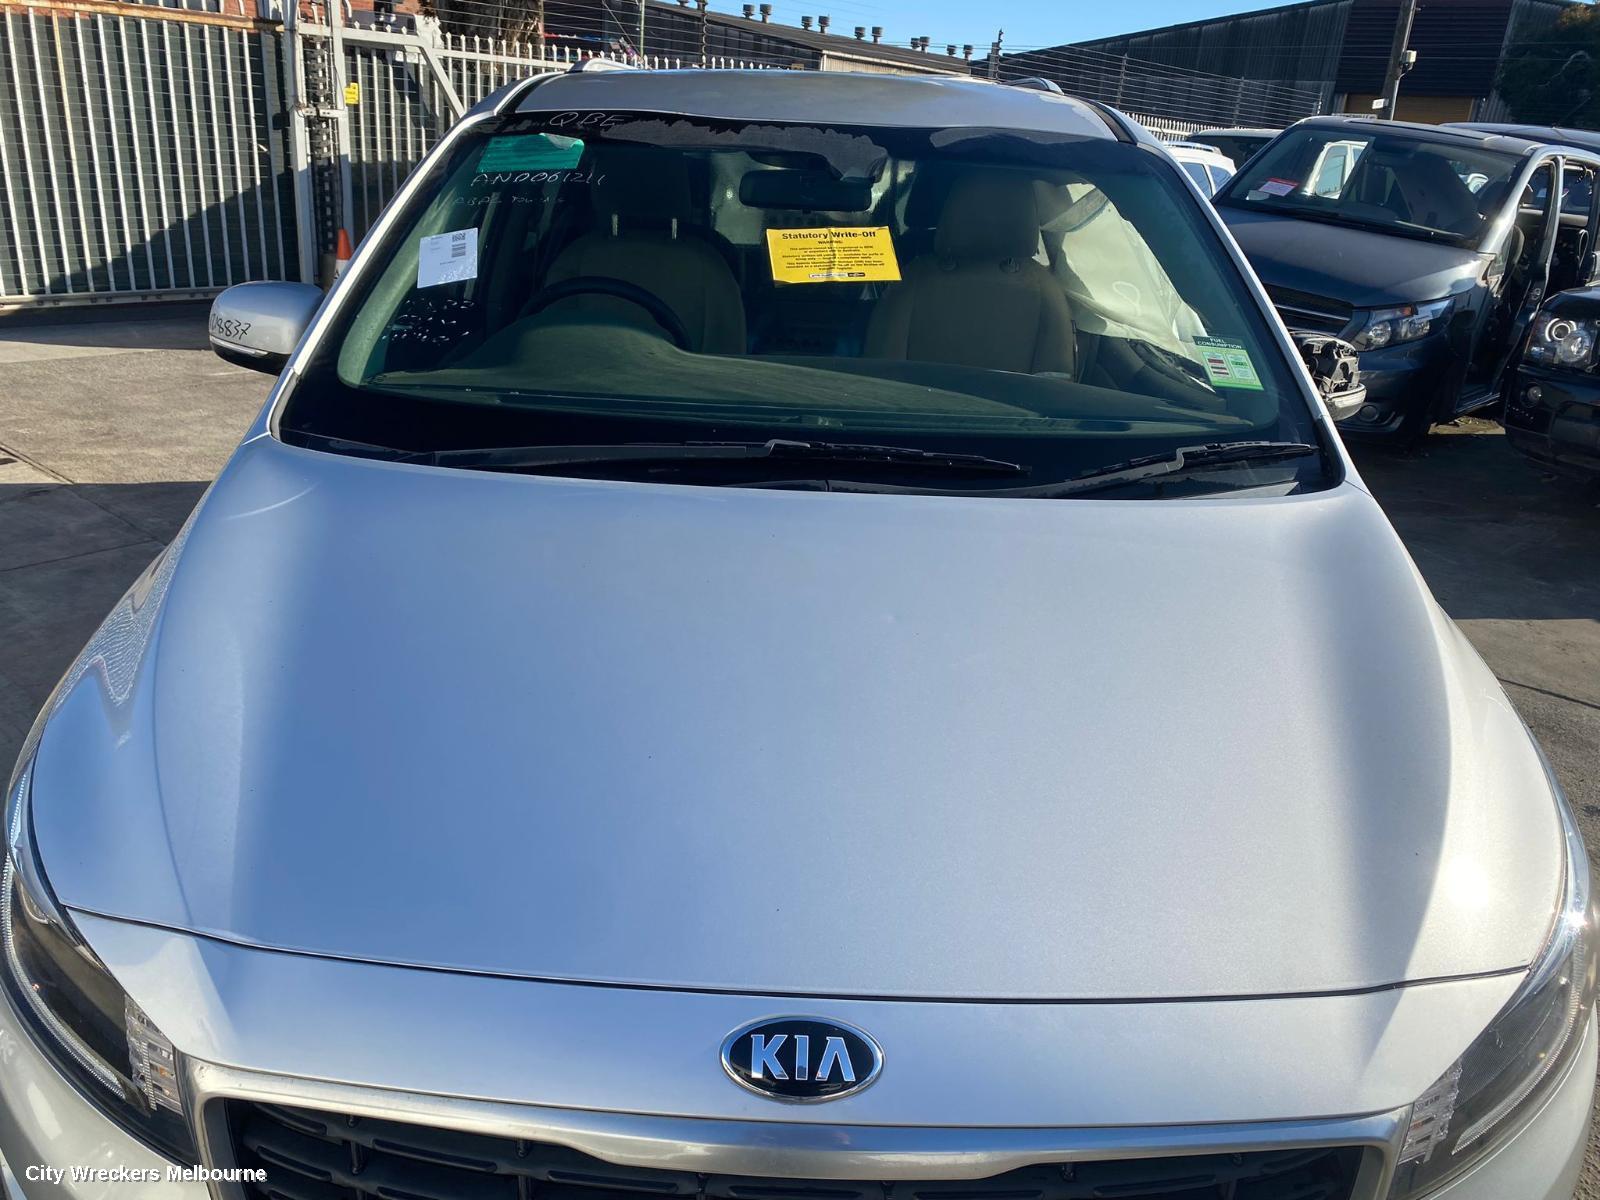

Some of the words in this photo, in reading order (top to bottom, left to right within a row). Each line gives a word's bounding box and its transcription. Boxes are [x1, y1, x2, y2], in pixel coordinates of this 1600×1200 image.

[549, 112, 628, 128] QBE
[1197, 341, 1242, 349] CONSUMPTION
[750, 1034, 856, 1082] KIA
